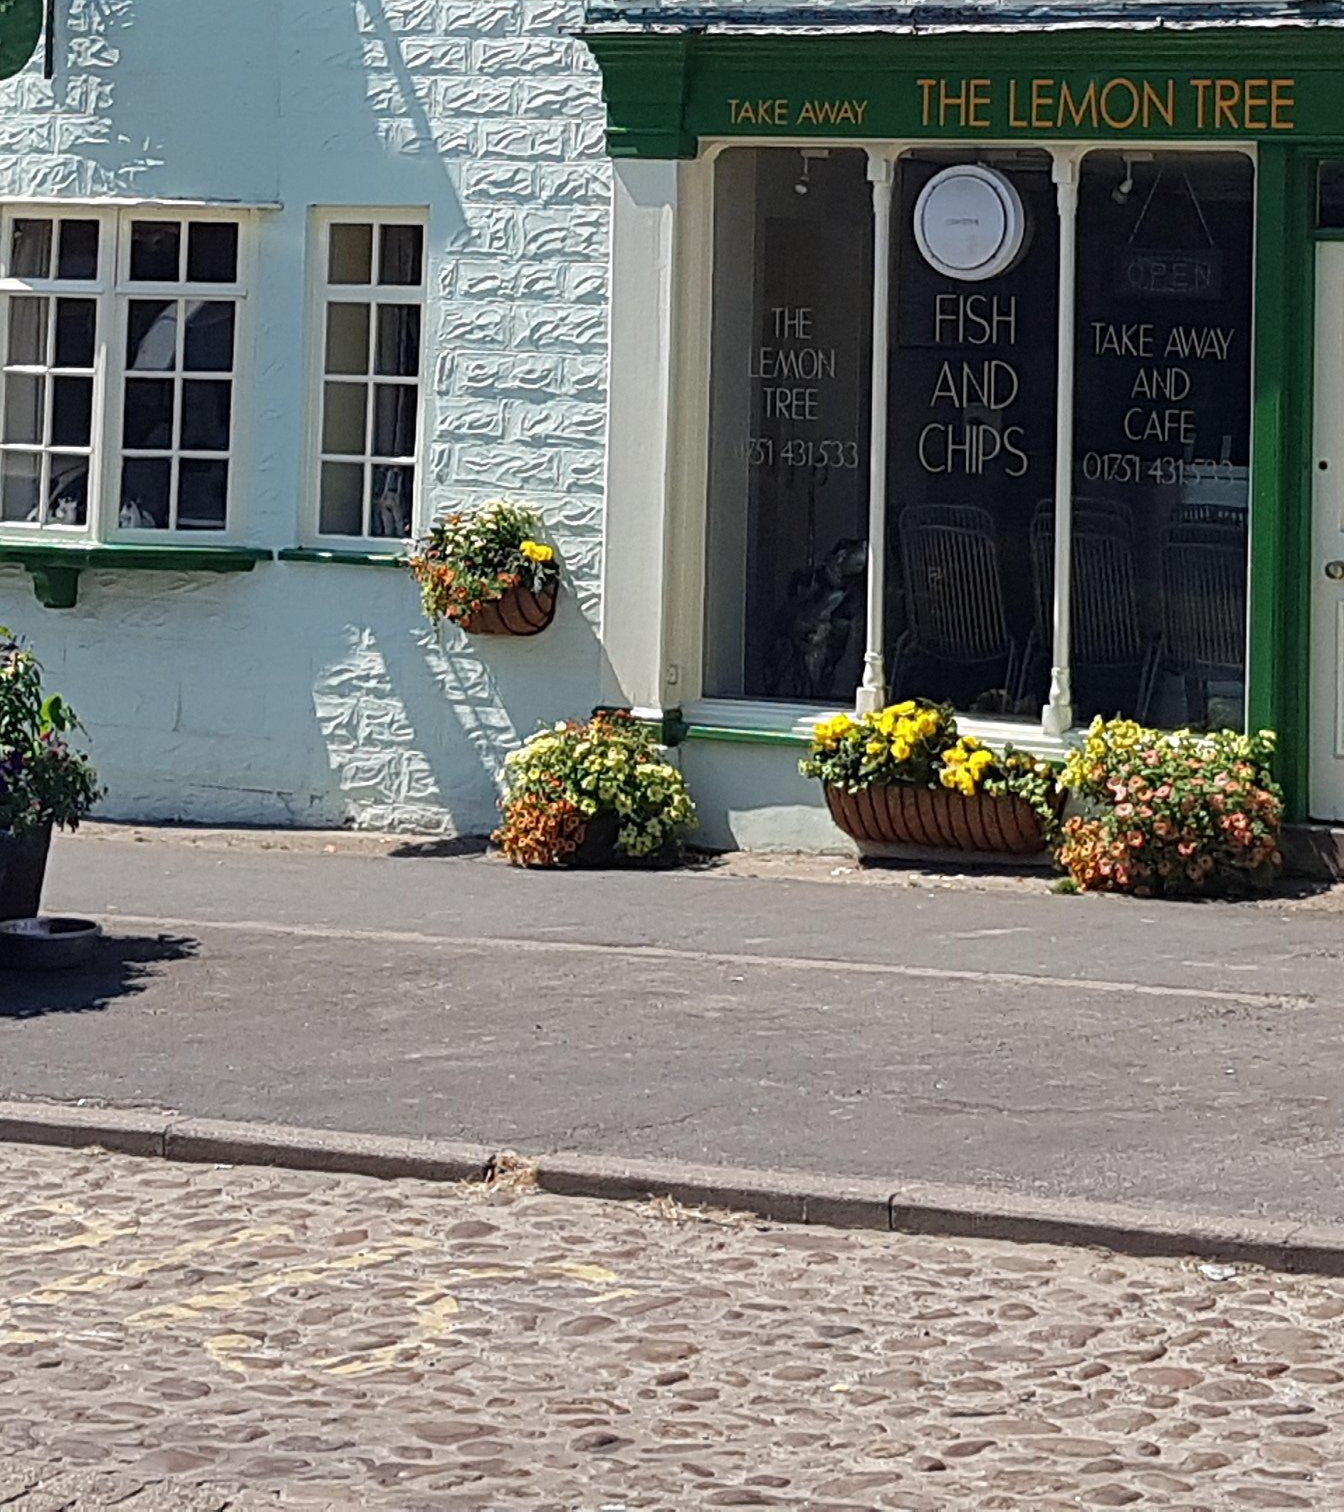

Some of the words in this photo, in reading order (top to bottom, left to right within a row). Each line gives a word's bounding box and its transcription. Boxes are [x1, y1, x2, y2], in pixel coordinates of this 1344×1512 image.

[728, 99, 788, 125] TAKE
[796, 99, 868, 126] AWAY
[917, 78, 991, 128] THE
[1009, 78, 1174, 129] LEMON
[1190, 78, 1295, 129] TREE
[1127, 261, 1212, 289] OPEN
[771, 307, 813, 340] THE
[935, 294, 1016, 345] FISH
[1091, 322, 1154, 357] TAKE
[1164, 325, 1235, 361] AWAY
[747, 346, 835, 379] LEMON
[929, 360, 1019, 410] AND
[1131, 367, 1190, 401] AND
[763, 388, 819, 420] TREE
[1124, 407, 1196, 444] CAFE
[918, 423, 1029, 477] CHIPS
[1083, 451, 1141, 483] 01751
